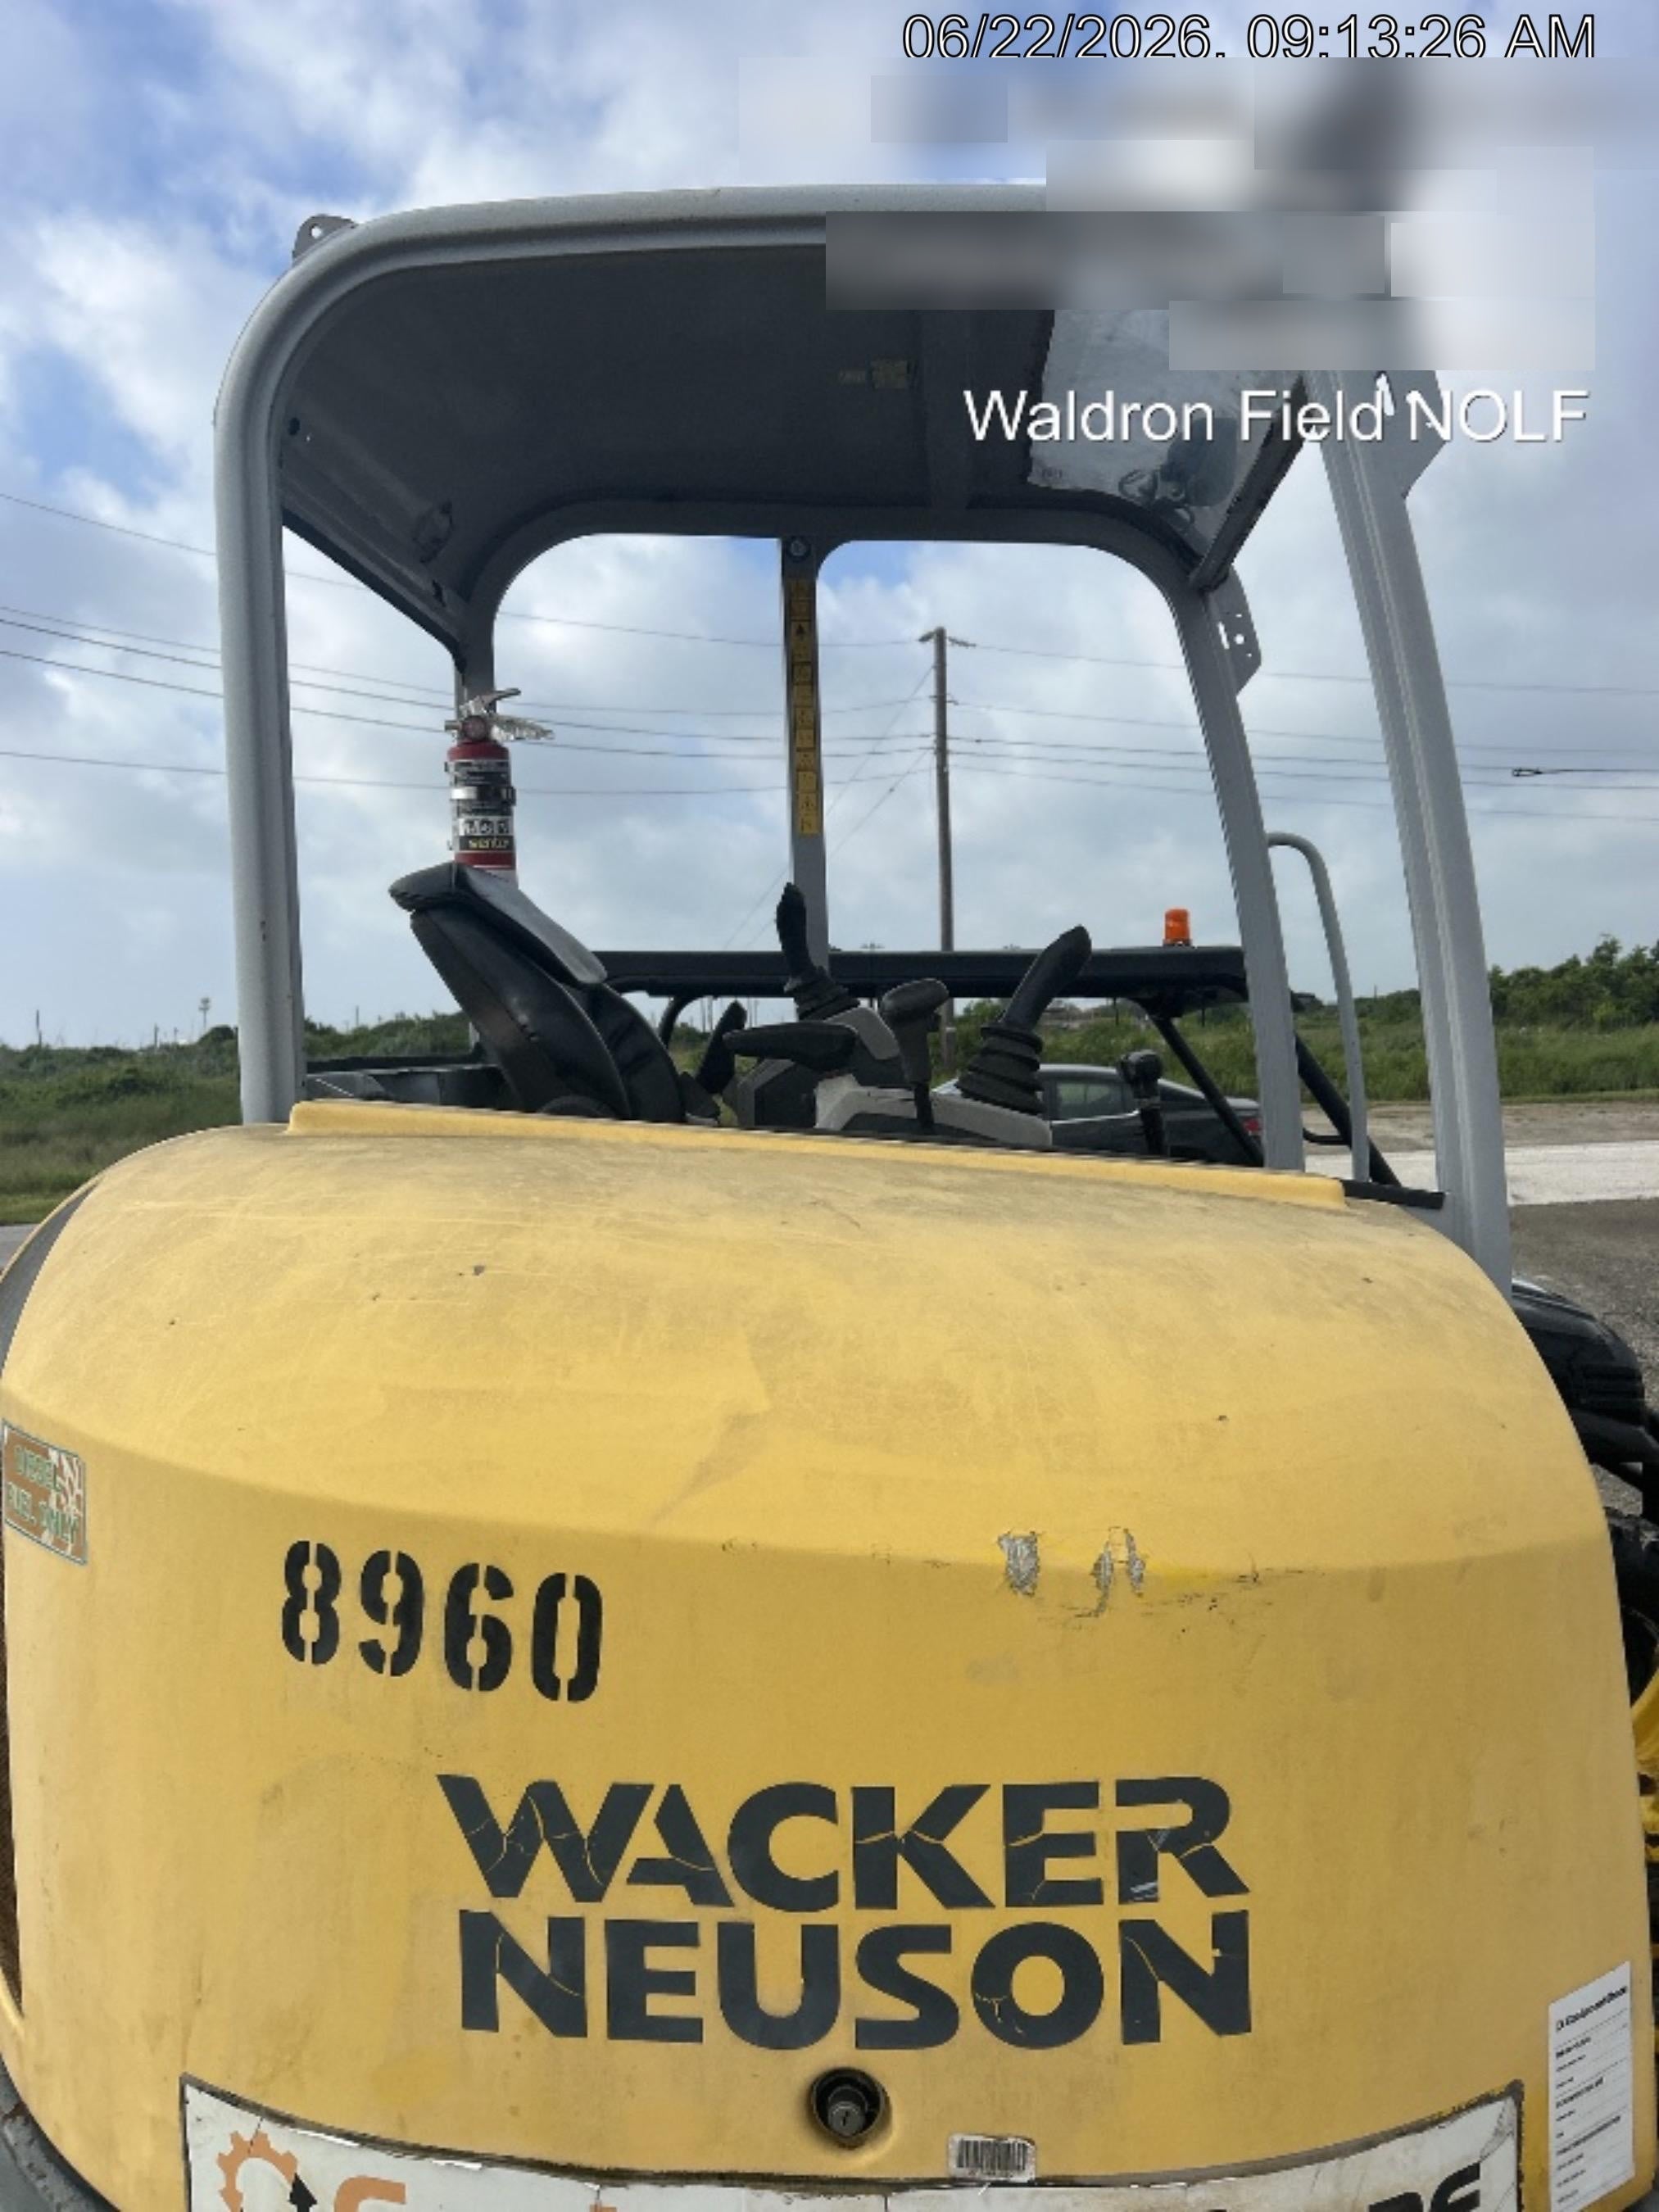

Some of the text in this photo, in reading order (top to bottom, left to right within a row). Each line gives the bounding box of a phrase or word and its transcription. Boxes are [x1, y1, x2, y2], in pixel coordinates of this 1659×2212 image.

[281, 1539, 605, 1703] 8960
[435, 1774, 1251, 1914] WACKER
[458, 1908, 1253, 2051] NEUSON
